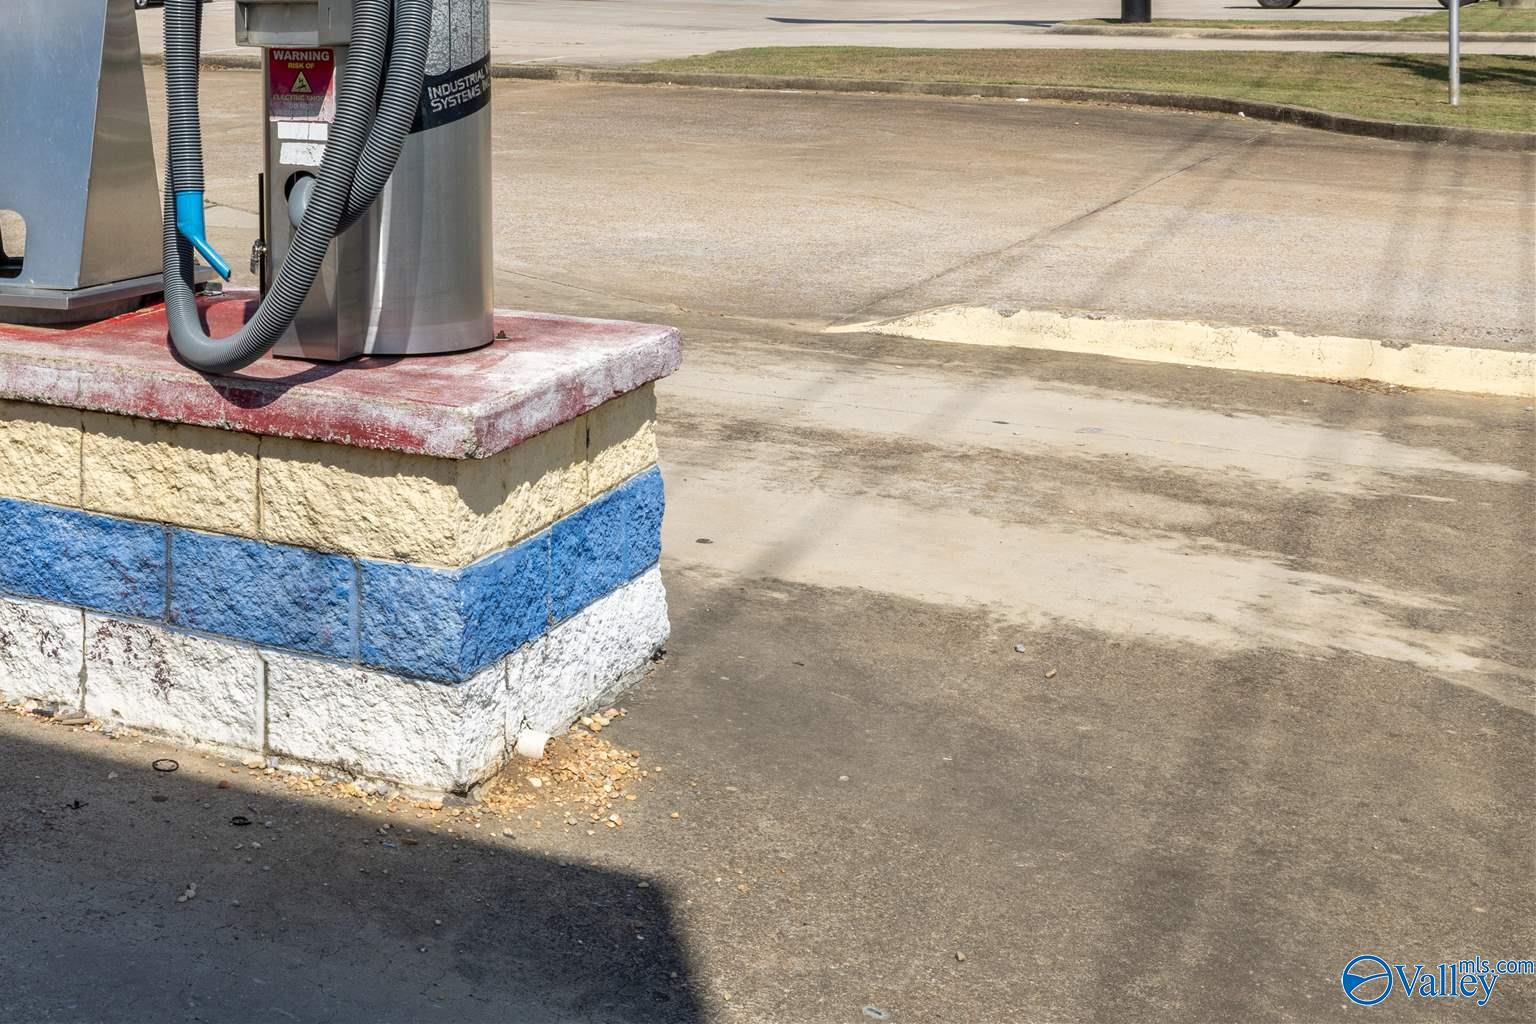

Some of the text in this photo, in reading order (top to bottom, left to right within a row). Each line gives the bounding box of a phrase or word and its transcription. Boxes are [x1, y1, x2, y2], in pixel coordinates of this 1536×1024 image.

[273, 50, 330, 61] WARNING
[428, 68, 485, 100] INDUSTRIAL
[430, 84, 481, 112] SYSTEMS
